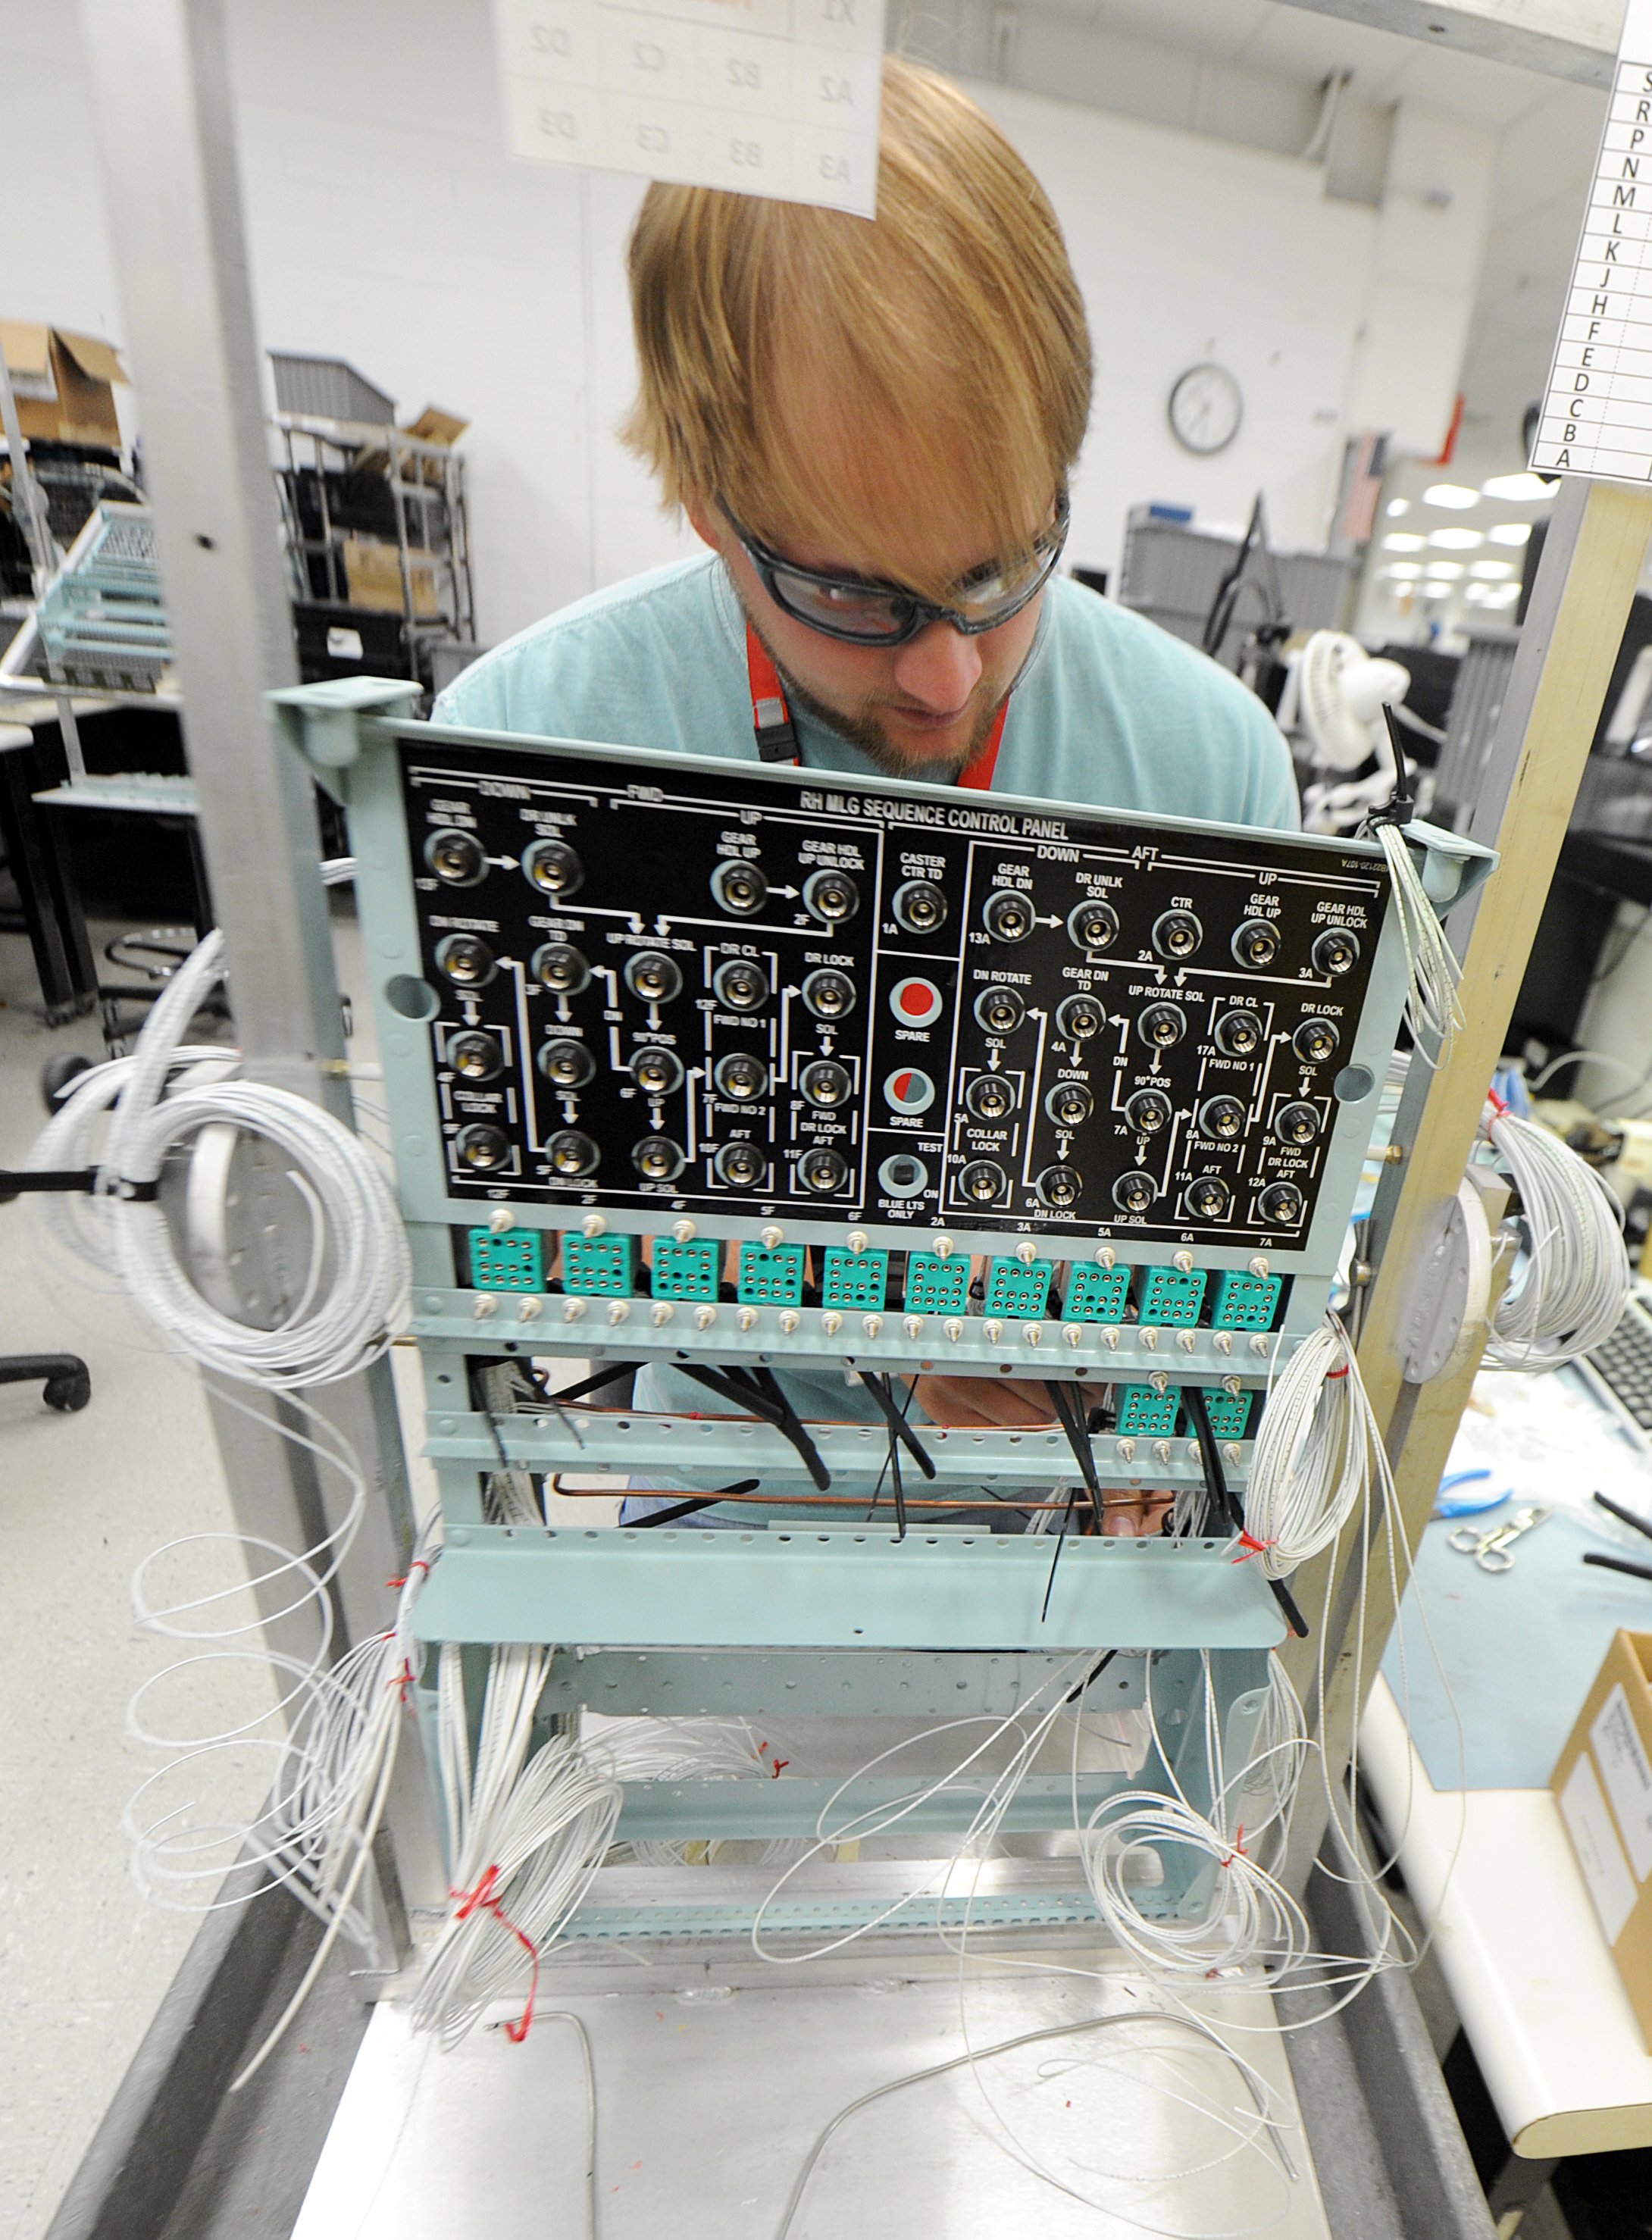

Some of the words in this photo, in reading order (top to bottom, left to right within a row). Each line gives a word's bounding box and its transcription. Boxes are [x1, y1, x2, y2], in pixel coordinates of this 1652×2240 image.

[1637, 100, 1650, 121] R
[1631, 129, 1644, 149] P
[1622, 157, 1640, 179] N
[1613, 185, 1636, 207] M
[1613, 213, 1622, 233] L
[1605, 240, 1621, 261] K
[1600, 267, 1610, 288] J
[1591, 294, 1608, 315] H
[1588, 321, 1600, 340] F
[1582, 347, 1594, 367] E
[1574, 374, 1589, 392] D
[1569, 399, 1584, 418] C
[1563, 424, 1576, 442] B
[1556, 449, 1570, 468] A
[740, 810, 763, 825] UP
[800, 790, 824, 811] RH
[862, 797, 946, 825] SEQUENCE
[947, 809, 1020, 834] CONTROL
[1022, 818, 1069, 840] PANEL
[721, 831, 757, 846] GEAR
[802, 840, 837, 855] GEAR
[837, 843, 862, 858] HDL
[1036, 844, 1081, 863] DOWN
[1131, 845, 1159, 861] AFT
[798, 852, 817, 865] UP
[816, 855, 865, 870] UNLOCK
[900, 852, 946, 868] CASTER
[901, 865, 926, 878] CTR
[927, 868, 943, 880] TD
[997, 863, 1031, 878] GEAR
[992, 874, 1015, 888] HDL
[1016, 878, 1034, 890] DN
[1075, 871, 1092, 884] DR
[1093, 874, 1123, 888] UNLK
[1258, 871, 1278, 886] UP
[1086, 885, 1109, 899] SOL
[1170, 896, 1193, 909] CTR
[1250, 893, 1280, 906] GEAR
[1244, 904, 1264, 917] HDL
[1266, 906, 1282, 918] UP
[1316, 901, 1346, 915] GEAR
[1346, 904, 1367, 918] HDL
[1310, 912, 1326, 924] UP
[1326, 914, 1368, 929] UNLOCK
[881, 923, 899, 935] 1A
[605, 931, 625, 945] UP
[671, 939, 697, 952] SOL
[969, 931, 991, 945] 13A
[721, 942, 740, 955] DR
[741, 945, 760, 957] CL
[1137, 949, 1153, 962] 2A
[804, 952, 823, 964] DR
[823, 954, 855, 967] LOCK
[973, 968, 989, 982] DN
[990, 971, 1032, 985] ROTATE
[1062, 966, 1092, 980] GEAR
[1093, 969, 1109, 982] DN
[1298, 967, 1313, 979] 3A
[1077, 979, 1092, 991] TD
[1128, 985, 1144, 996] UP
[1144, 987, 1183, 1000] ROTATE
[1185, 990, 1206, 1003] SOL
[1229, 995, 1245, 1007] DR
[1245, 996, 1259, 1008] CL
[1300, 1003, 1316, 1014] DR
[1316, 1004, 1344, 1017] LOCK
[815, 1023, 839, 1036] SOL
[894, 1029, 931, 1043] SPARE
[985, 1037, 1007, 1050] SOL
[1050, 1041, 1066, 1053] 4A
[1197, 1045, 1216, 1056] 17A
[1112, 1056, 1128, 1067] DN
[1209, 1059, 1231, 1070] FWD
[1232, 1060, 1247, 1072] NO
[1248, 1061, 1255, 1072] 1
[1057, 1068, 1089, 1081] DOWN
[1298, 1065, 1318, 1076] SOL
[714, 1103, 740, 1114] FWD
[740, 1105, 757, 1115] NO
[758, 1106, 766, 1116] 2
[812, 1110, 837, 1122] FWD
[890, 1115, 925, 1128] SPARE
[954, 1113, 970, 1124] 5A
[729, 1129, 752, 1139] AFT
[800, 1122, 818, 1133] DR
[818, 1123, 847, 1134] LOCK
[966, 1128, 1008, 1140] COLLAR
[1055, 1129, 1075, 1140] SOL
[1113, 1125, 1128, 1136] 7A
[1185, 1129, 1200, 1140] 8A
[812, 1135, 834, 1146] AFT
[917, 1141, 943, 1153] TEST
[971, 1140, 1000, 1152] LOCK
[1137, 1136, 1151, 1146] UP
[1194, 1140, 1216, 1151] FWD
[1216, 1142, 1231, 1152] NO
[1232, 1143, 1239, 1153] 2
[1262, 1136, 1277, 1147] 9A
[1280, 1146, 1302, 1157] FWD
[946, 1154, 967, 1165] 10A
[1267, 1156, 1283, 1167] DR
[1283, 1158, 1309, 1169] LOCK
[1175, 1171, 1193, 1182] 11A
[1203, 1165, 1222, 1175] AFT
[1277, 1169, 1296, 1179] AFT
[1248, 1178, 1266, 1188] 12A
[923, 1189, 939, 1199] ON
[878, 1198, 906, 1210] BLUE
[906, 1200, 925, 1211] LTS
[1025, 1198, 1040, 1209] 6A
[848, 1212, 862, 1222] 6F
[887, 1209, 915, 1220] ONLY
[1034, 1209, 1049, 1219] DN
[1050, 1210, 1077, 1221] LOCK
[1114, 1214, 1128, 1224] UP
[1128, 1215, 1147, 1225] SOL
[931, 1216, 946, 1227] 2A
[1017, 1222, 1031, 1232] 3A
[1097, 1228, 1112, 1237] 5A
[1181, 1232, 1194, 1243] 6A
[1259, 1237, 1273, 1247] 7A
